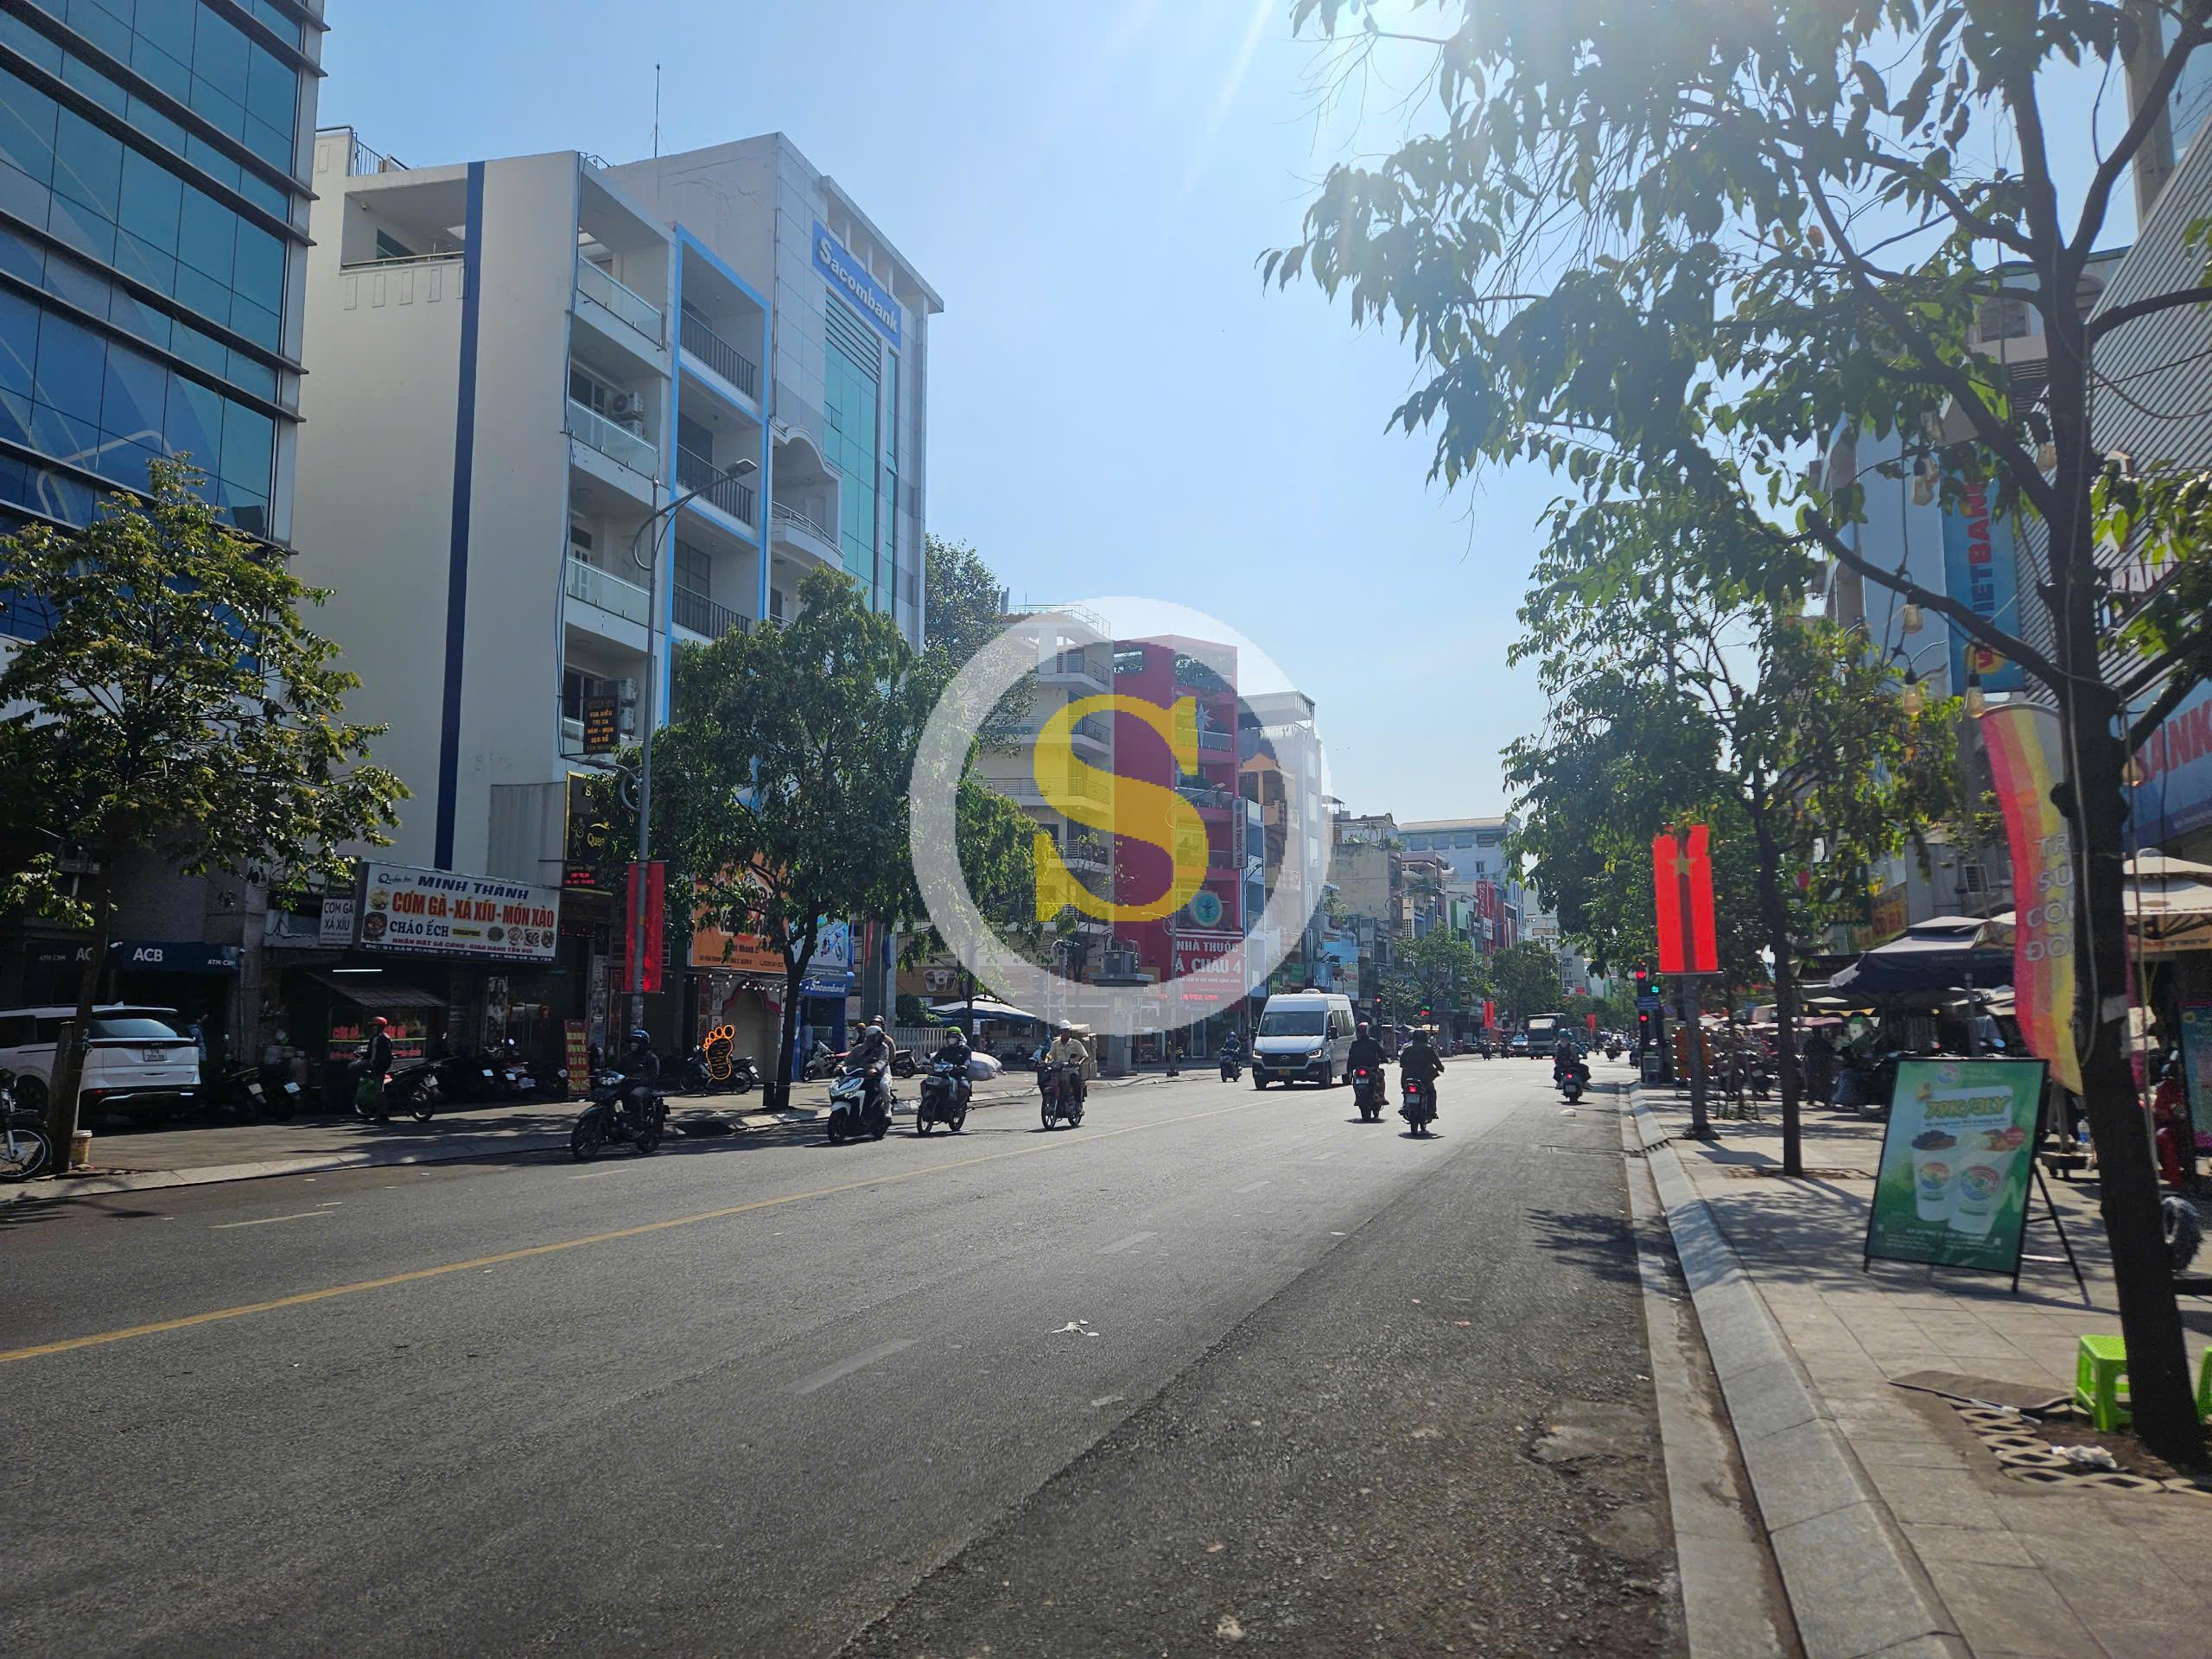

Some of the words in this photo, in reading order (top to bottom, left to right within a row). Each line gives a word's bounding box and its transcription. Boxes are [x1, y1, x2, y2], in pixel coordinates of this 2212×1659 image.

[819, 237, 897, 333] Sacombank
[418, 875, 468, 892] MINH
[392, 890, 424, 914] CƠM
[428, 893, 448, 917] GÀ
[454, 897, 472, 919] XÁ
[473, 899, 497, 922] XÍU
[502, 903, 530, 925] MÓN
[531, 906, 554, 928] XÀO
[390, 918, 423, 935] CHÁO
[425, 918, 449, 938] ẾCH
[1176, 939, 1200, 951] NHÀ
[75, 947, 93, 961] AC
[133, 947, 163, 962] ACB
[1232, 960, 1242, 974] 4
[810, 979, 846, 993] Sacombank
